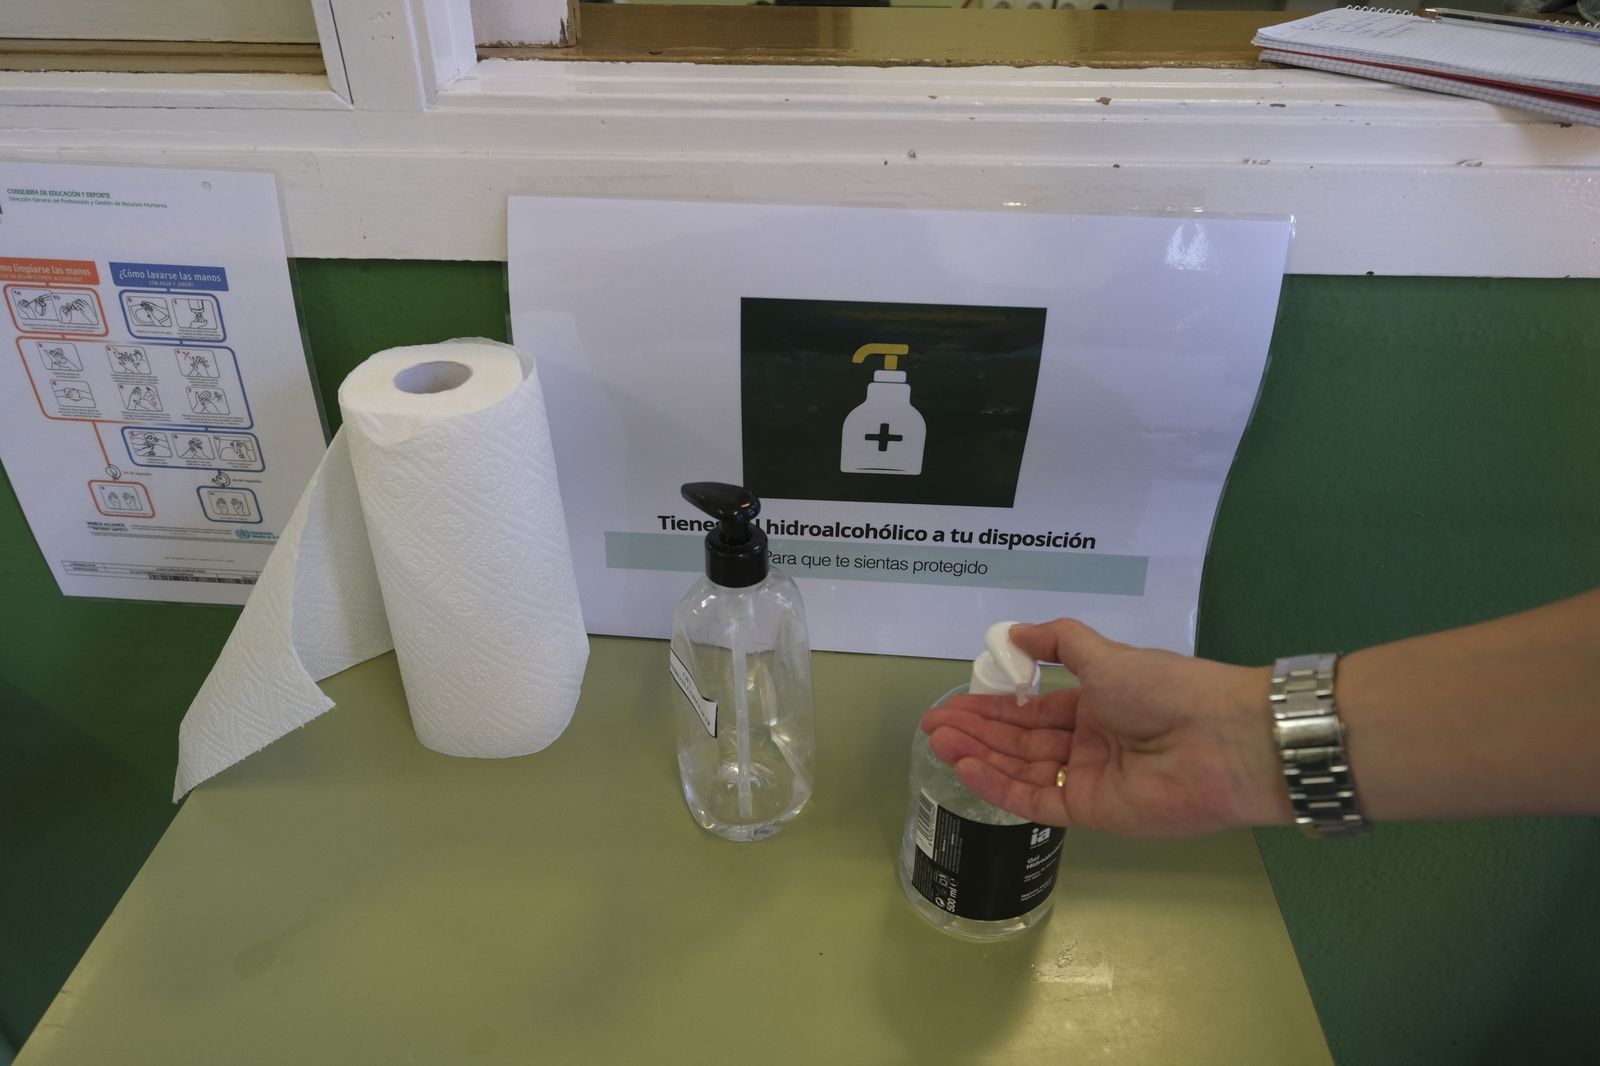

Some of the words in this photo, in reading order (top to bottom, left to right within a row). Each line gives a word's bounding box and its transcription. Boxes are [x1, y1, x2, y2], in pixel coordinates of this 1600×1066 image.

[86, 191, 111, 199] DEPORTE
[13, 263, 50, 274] limpiarse
[51, 264, 64, 275] las
[65, 267, 92, 276] manos
[119, 268, 145, 280] ¿Cómo
[147, 269, 178, 281] lavarse
[179, 271, 192, 281] las
[194, 273, 222, 283] manos
[766, 519, 926, 542] hidroalcohólico
[932, 529, 945, 543] a
[950, 528, 973, 544] tu
[978, 528, 1096, 551] disposición
[801, 553, 832, 569] que
[836, 555, 850, 568] te
[854, 555, 909, 571] sientas
[912, 559, 988, 577] protegido
[1030, 827, 1051, 846] ia
[948, 886, 958, 899] ml
[946, 897, 956, 913] 500
